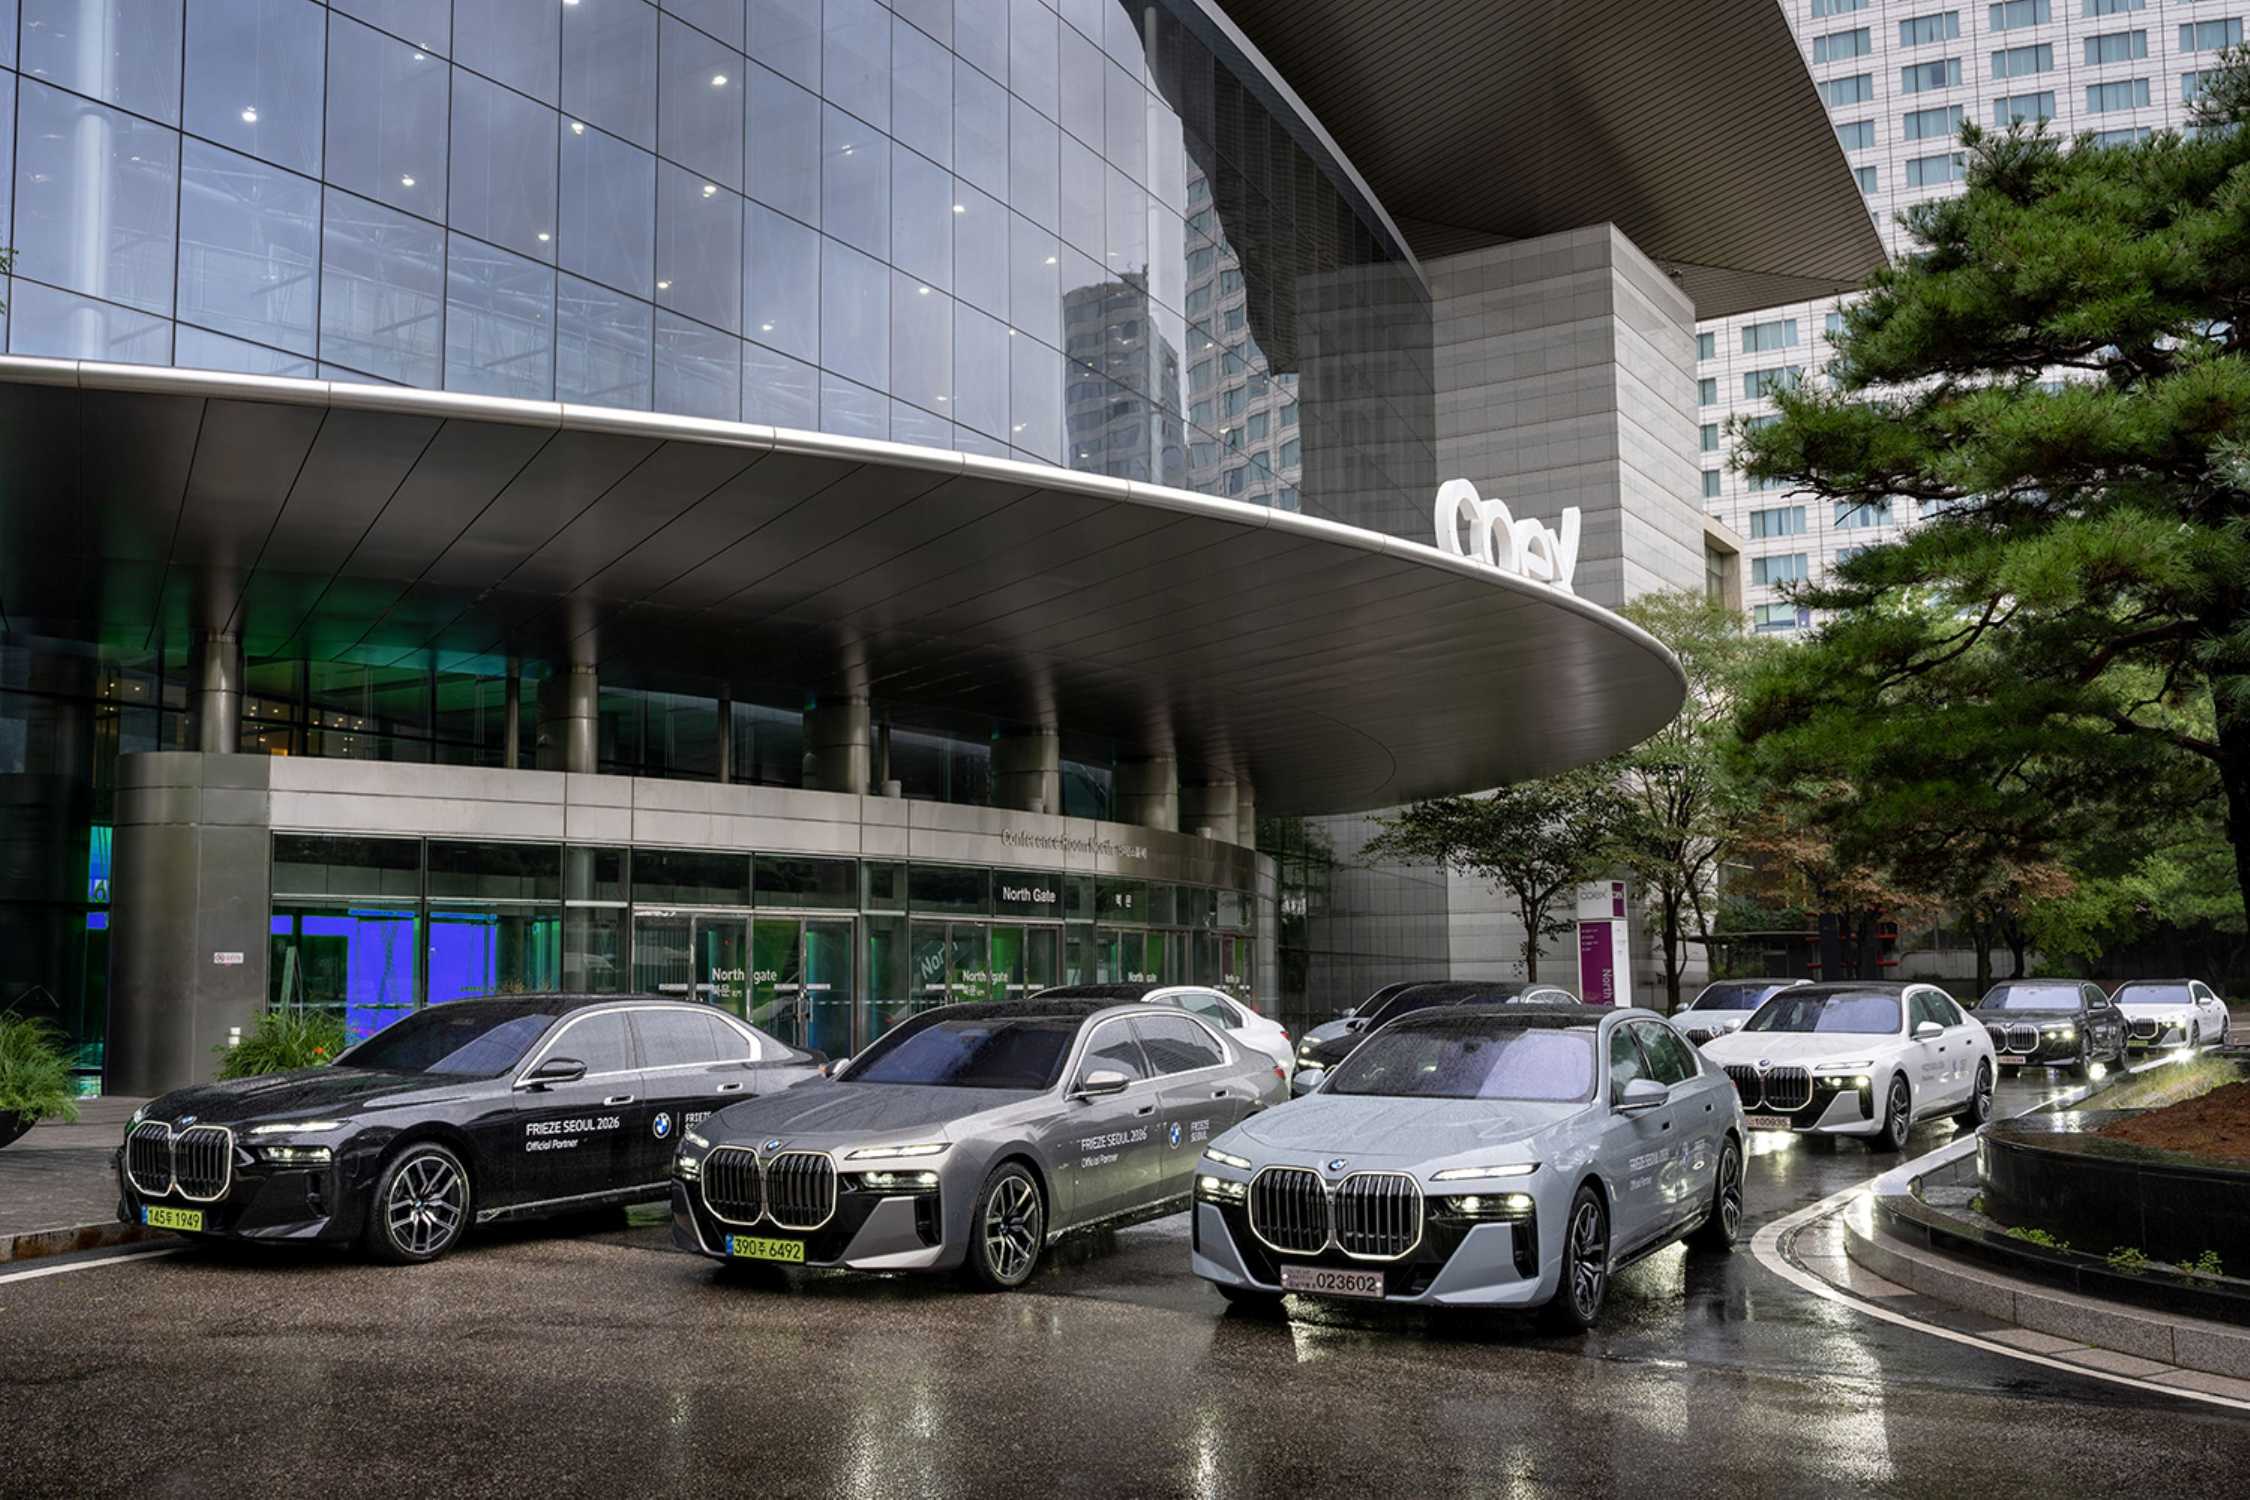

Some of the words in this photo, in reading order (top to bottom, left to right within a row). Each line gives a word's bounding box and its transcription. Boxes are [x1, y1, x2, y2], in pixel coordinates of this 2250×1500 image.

[1002, 886, 1031, 901] North
[1033, 888, 1056, 903] Gate
[712, 967, 745, 981] North
[753, 968, 778, 985] gate
[962, 969, 986, 982] North
[1602, 968, 1614, 999] North
[526, 1121, 561, 1136] FRIEZE
[563, 1118, 595, 1133] SEOUL
[597, 1116, 620, 1130] 2026
[526, 1140, 551, 1152] Official
[552, 1138, 579, 1150] Partner
[1081, 1133, 1107, 1151] FRIEZE
[1107, 1130, 1131, 1147] SEOUL
[176, 1211, 200, 1228] 1949
[769, 1242, 801, 1259] 6492
[1316, 1272, 1376, 1292] 023602
